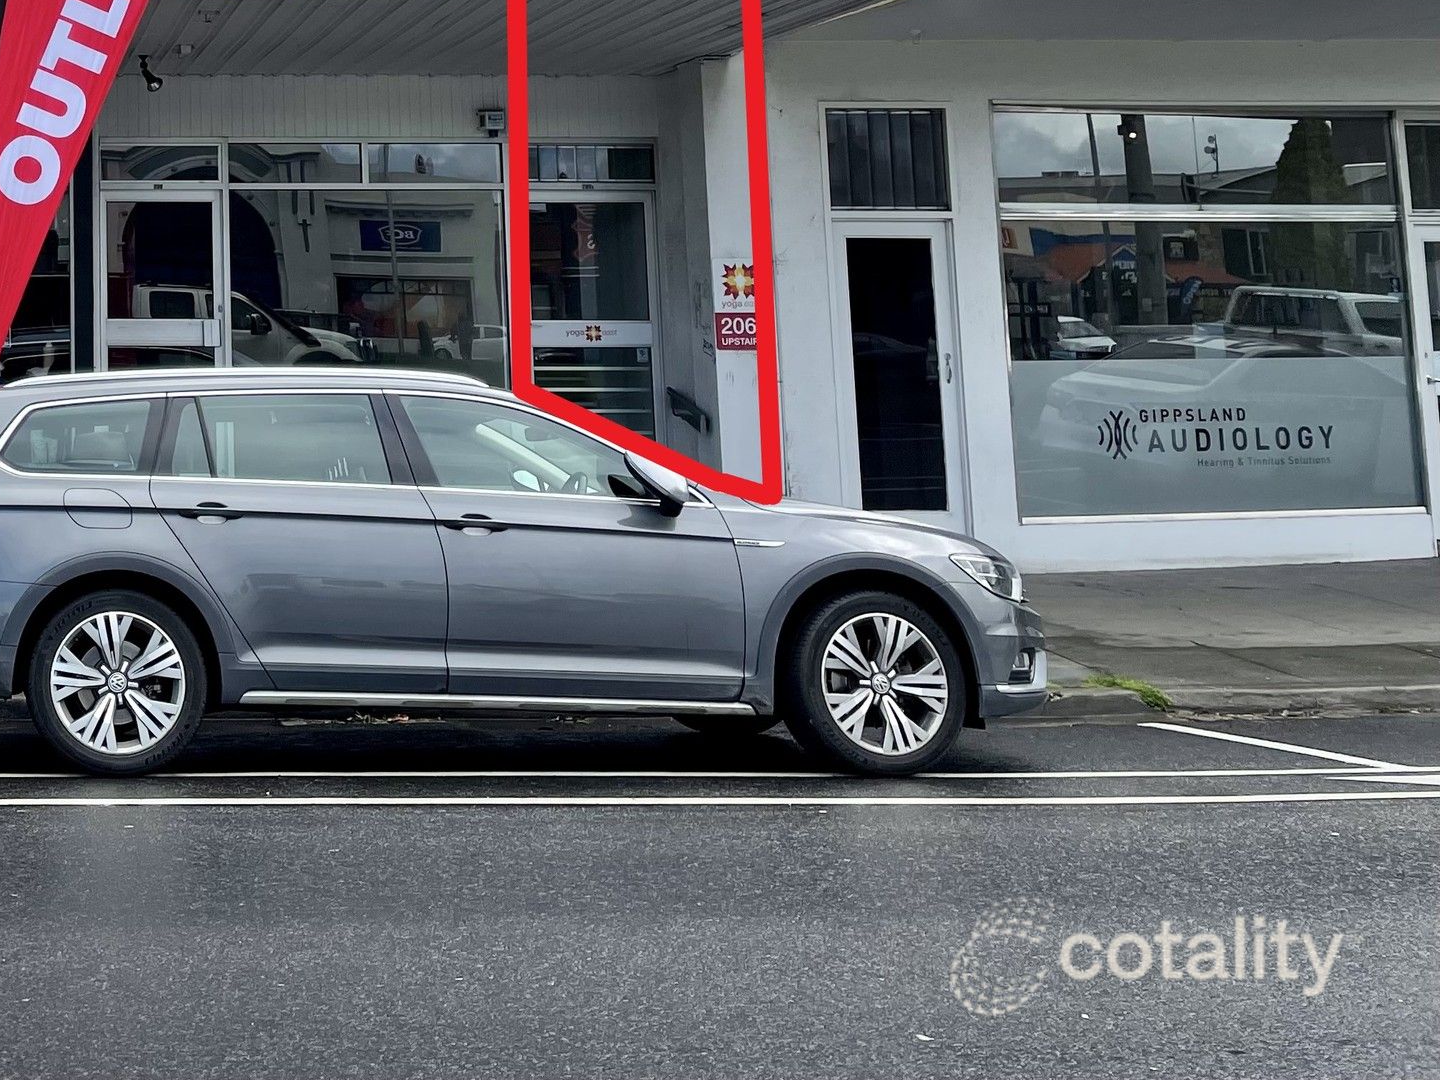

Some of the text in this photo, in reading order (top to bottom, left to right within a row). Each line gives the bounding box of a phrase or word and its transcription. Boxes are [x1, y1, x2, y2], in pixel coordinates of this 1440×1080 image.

[722, 300, 743, 310] yoga
[721, 317, 756, 335] 206
[1139, 407, 1247, 423] GIPPSLAND
[1148, 425, 1334, 453] AUDIOLOGY
[1197, 457, 1235, 469] Hearing
[1247, 456, 1286, 466] Tinnitus
[1288, 455, 1331, 466] Solutions
